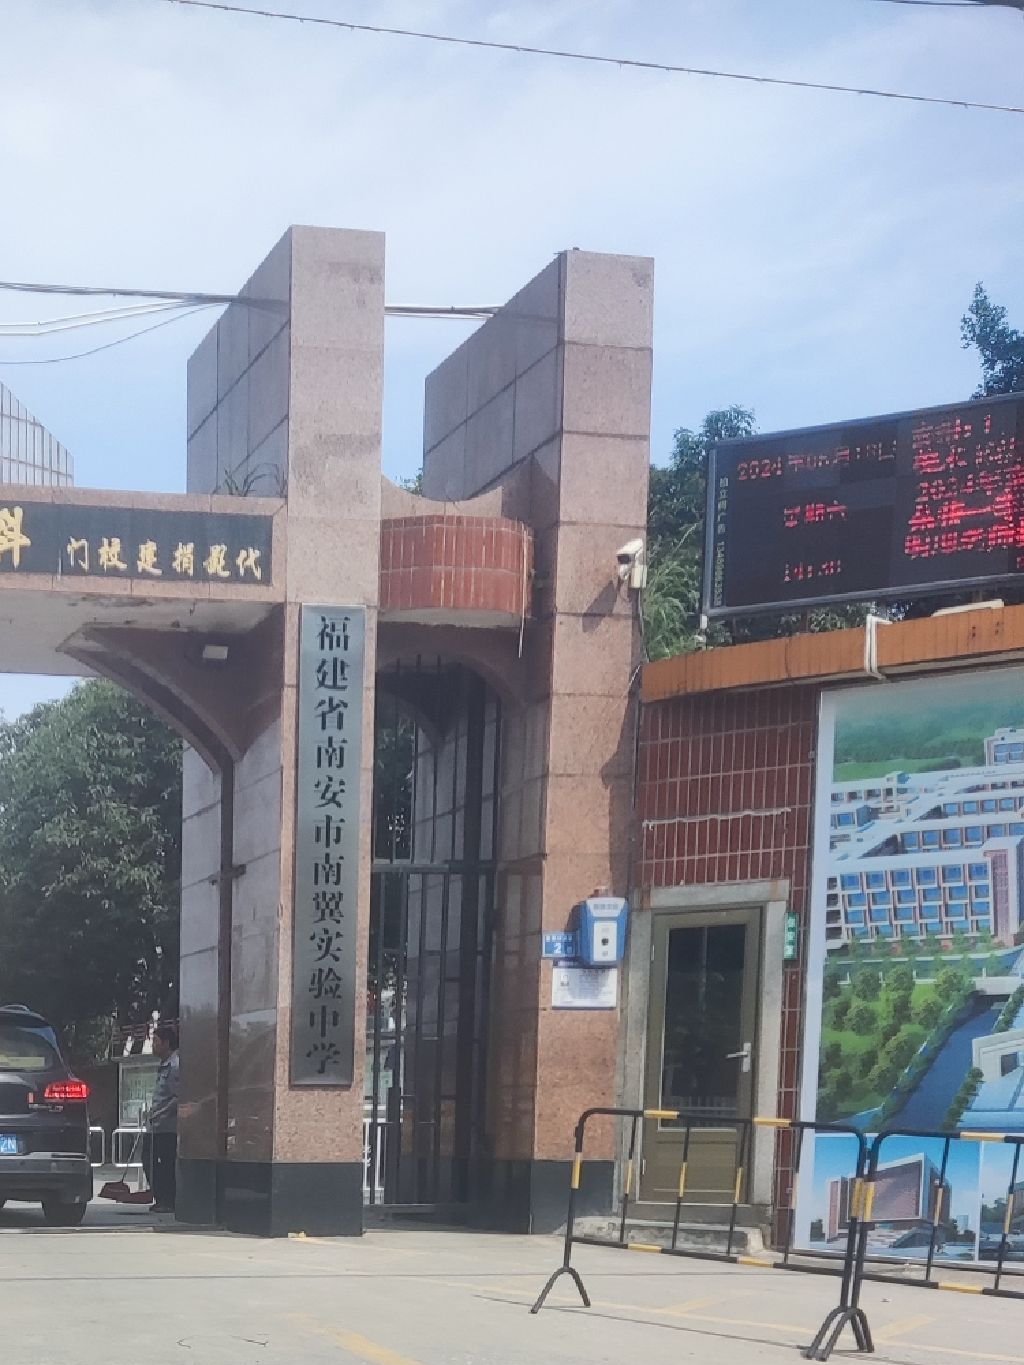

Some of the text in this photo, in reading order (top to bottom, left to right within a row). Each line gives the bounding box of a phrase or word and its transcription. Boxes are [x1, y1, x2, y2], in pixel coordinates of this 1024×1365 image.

[306, 615, 351, 1075] 福建省南安市南翼实验中学
